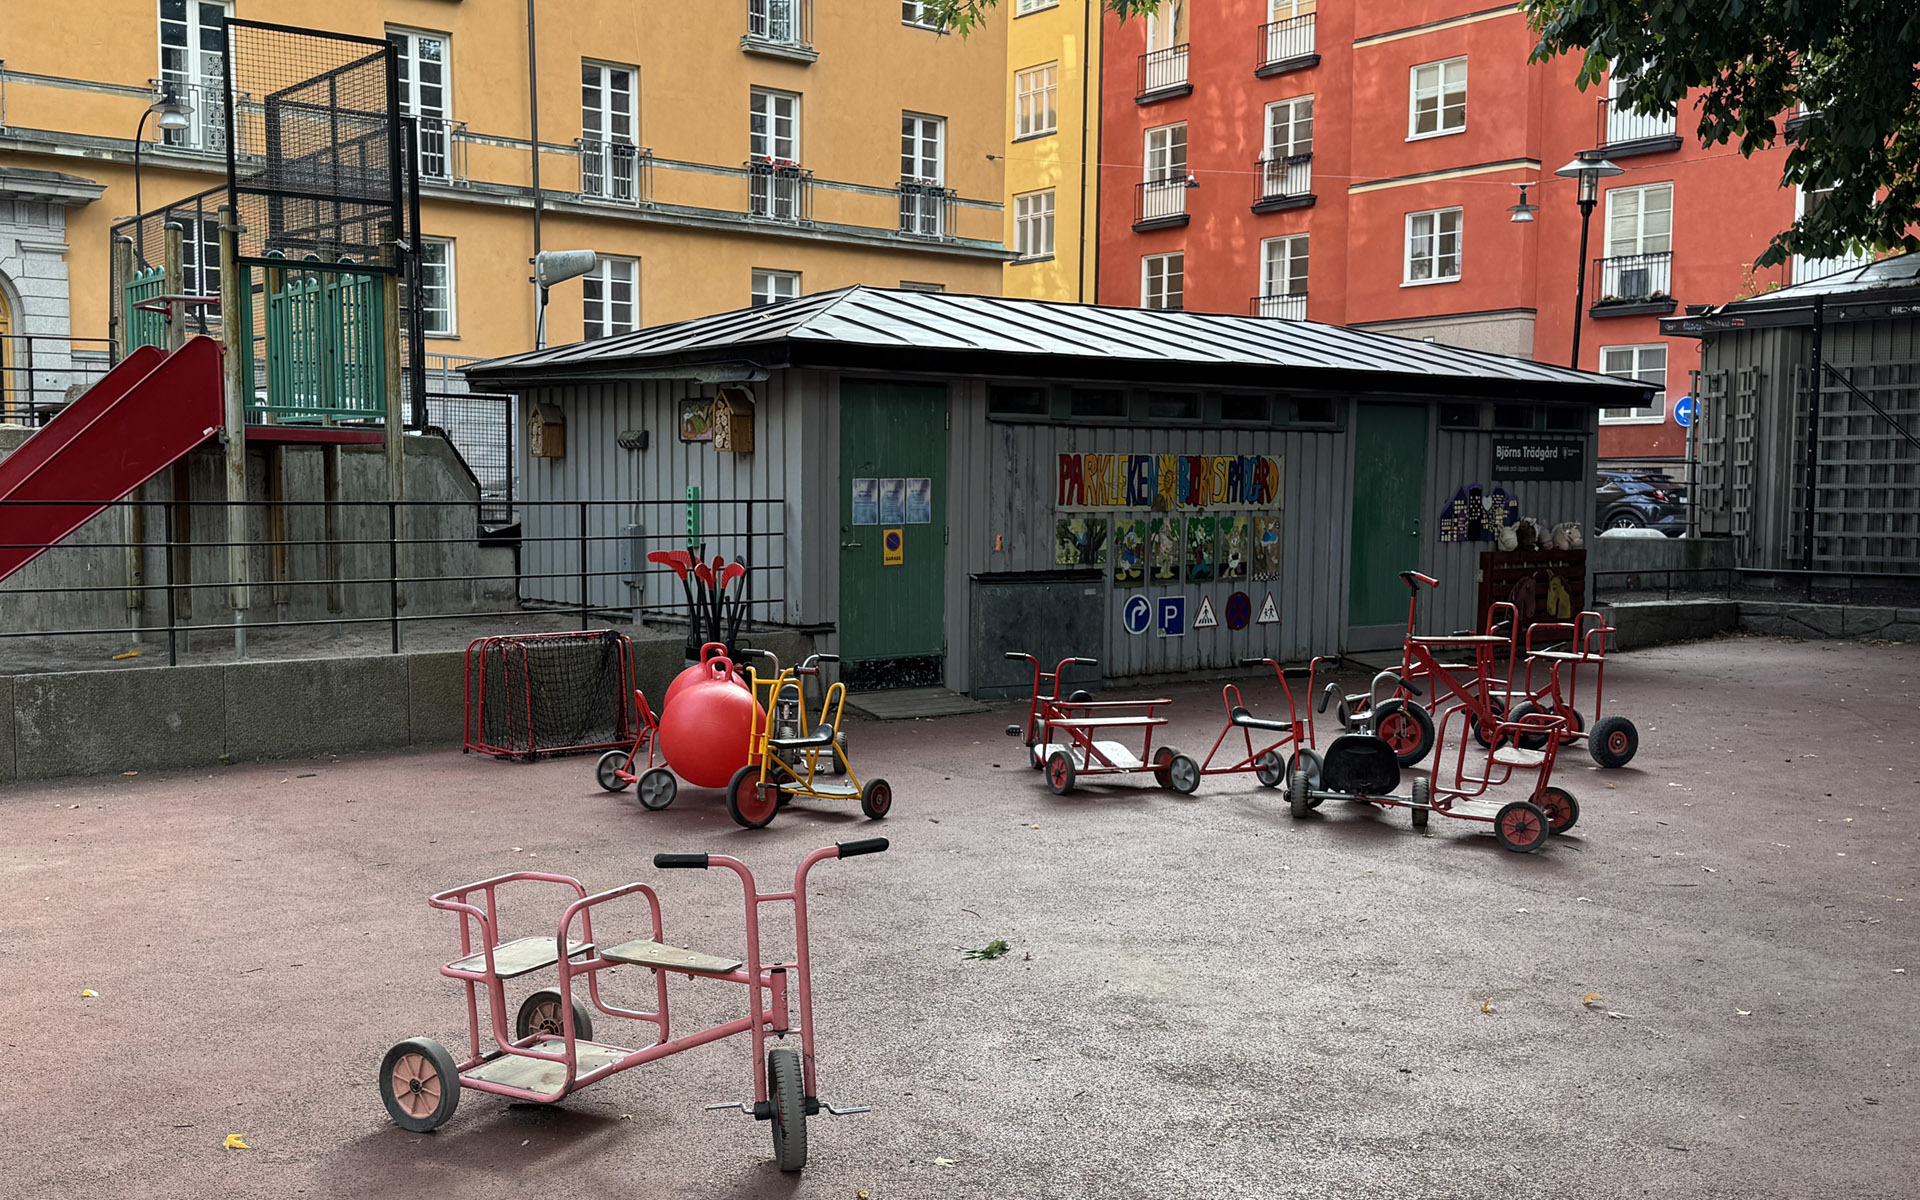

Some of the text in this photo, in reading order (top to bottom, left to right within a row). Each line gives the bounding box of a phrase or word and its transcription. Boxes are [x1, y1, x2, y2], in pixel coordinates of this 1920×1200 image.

[1496, 445, 1521, 460] Björns
[1522, 445, 1558, 461] Trädgård
[1058, 453, 1160, 506] PARKLEKEN
[1164, 605, 1178, 628] P
